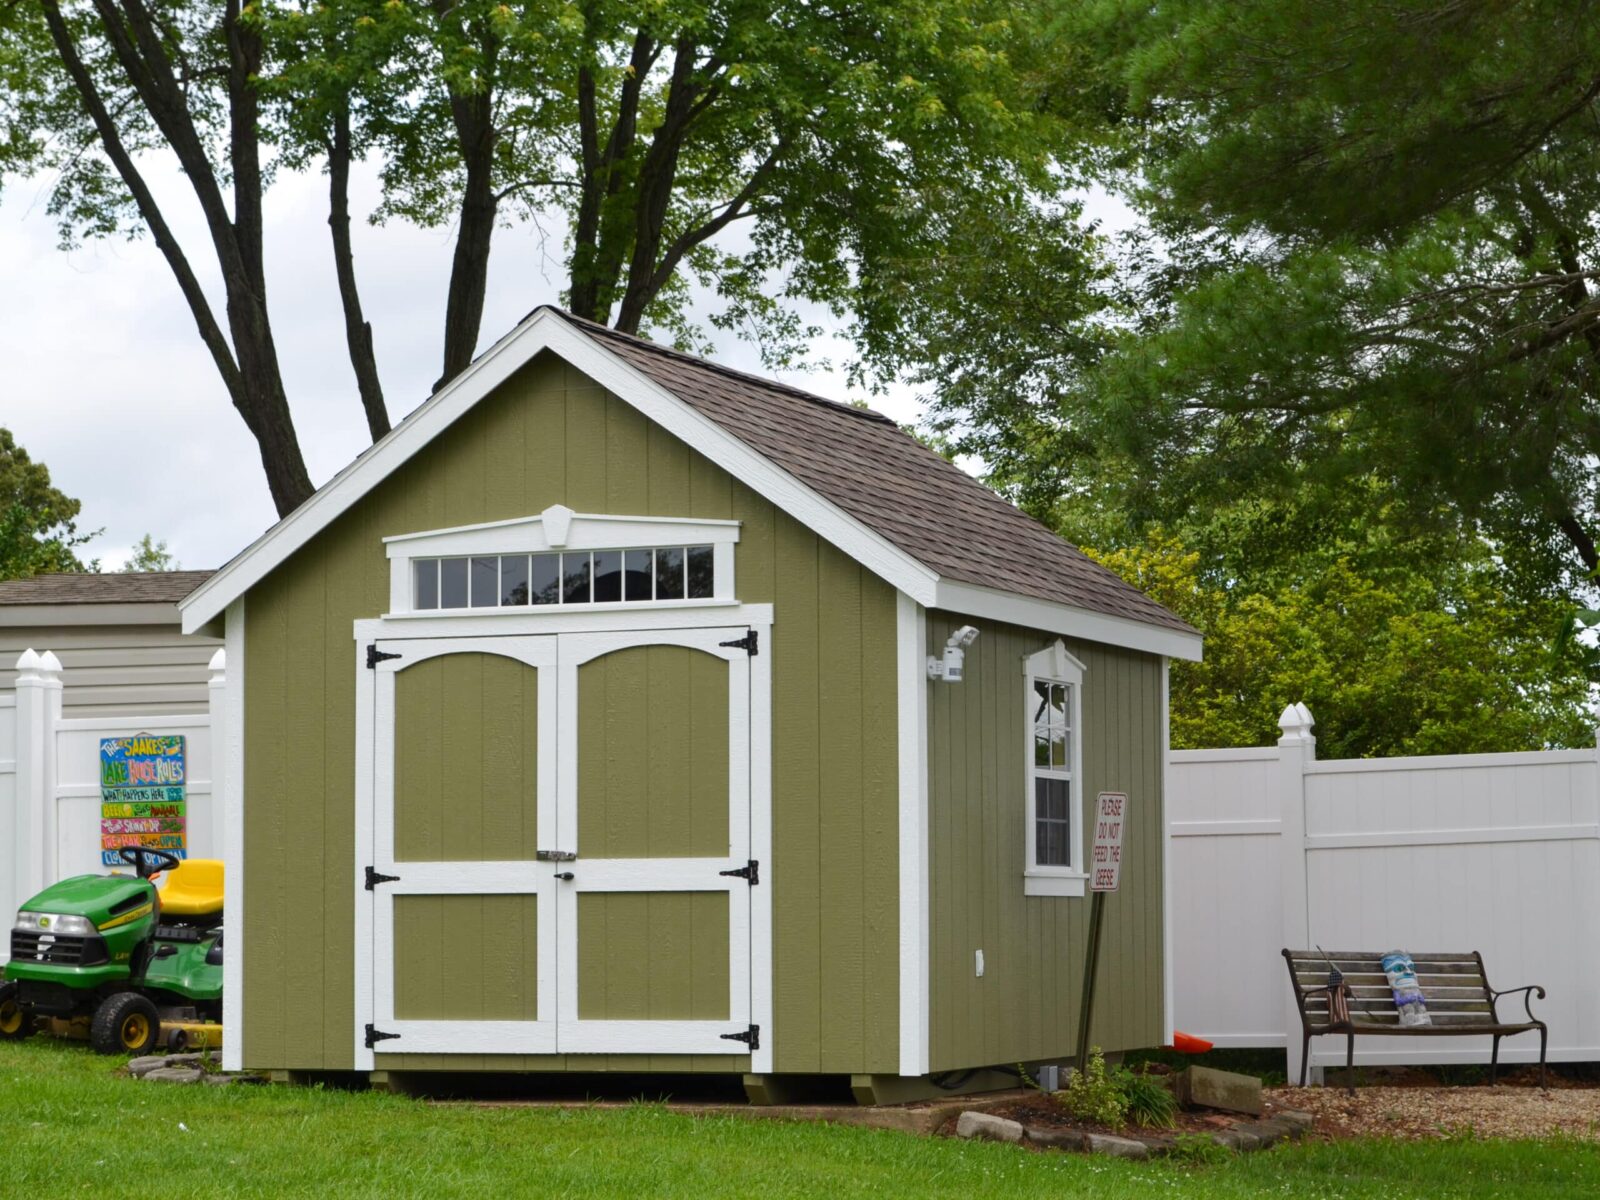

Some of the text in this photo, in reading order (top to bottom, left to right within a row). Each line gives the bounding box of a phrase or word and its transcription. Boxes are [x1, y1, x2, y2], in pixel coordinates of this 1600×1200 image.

[101, 740, 120, 757] THE
[101, 760, 127, 786] LAKE
[156, 758, 184, 784] RULES
[102, 788, 120, 801] WHAT
[123, 788, 149, 800] HAPPENS
[150, 787, 165, 800] HERE
[103, 804, 124, 817] BEER
[1101, 799, 1122, 816] PLEASE
[1098, 822, 1120, 839] DO NOT
[160, 835, 183, 848] OPEN
[1094, 845, 1120, 862] FEED THE
[1095, 868, 1114, 886] GEESE
